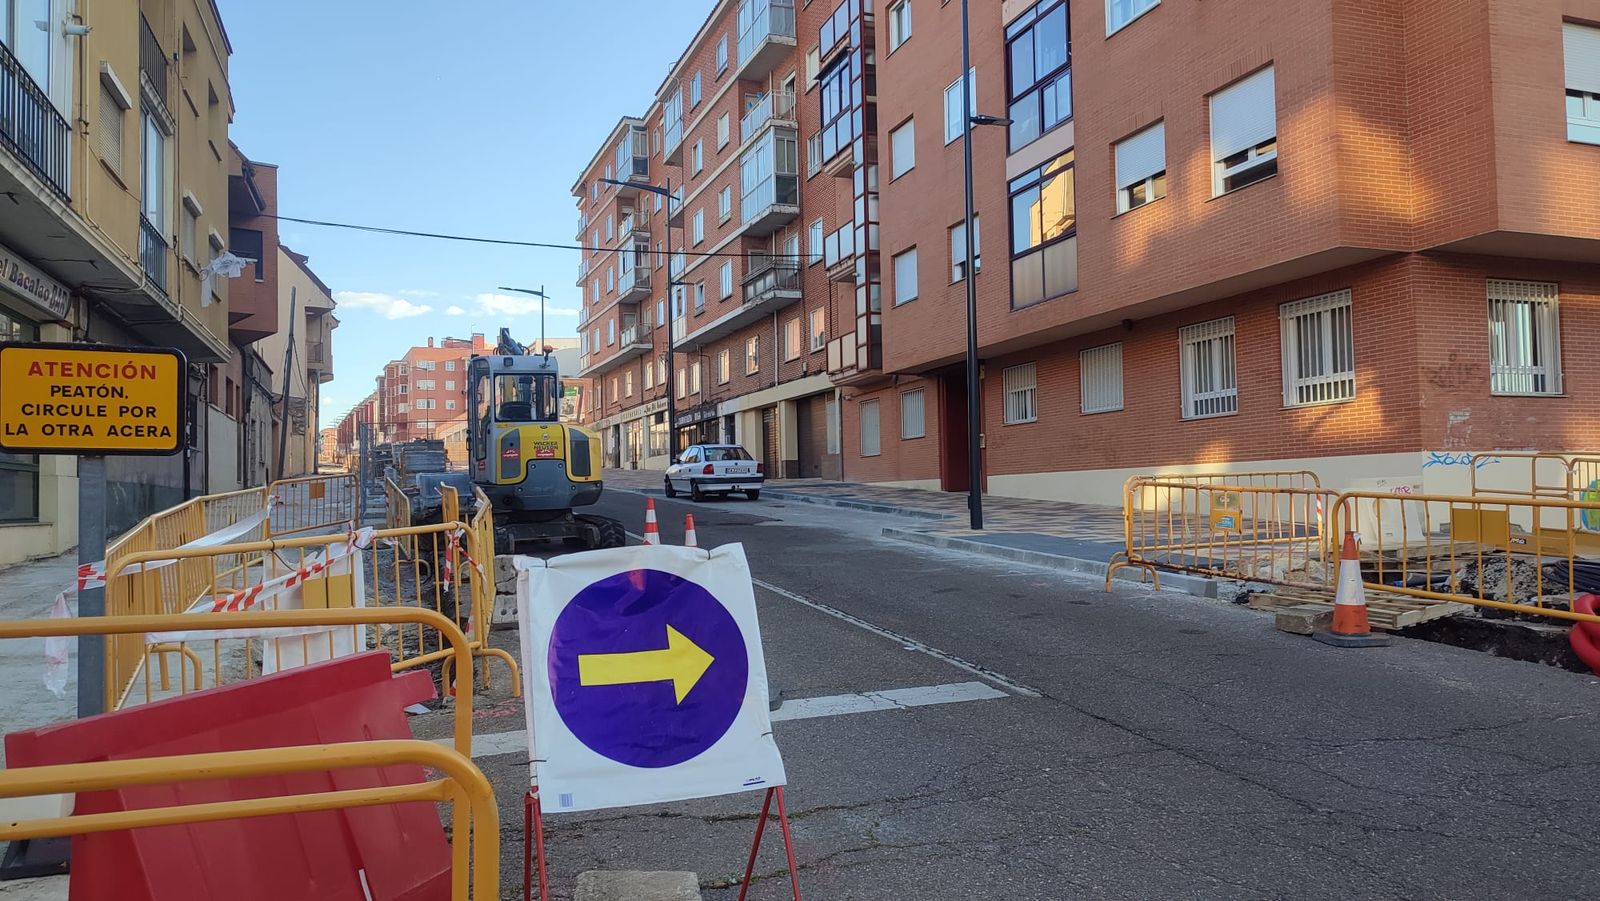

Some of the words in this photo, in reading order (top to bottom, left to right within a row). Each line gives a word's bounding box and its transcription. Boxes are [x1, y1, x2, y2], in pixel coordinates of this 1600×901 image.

[9, 262, 50, 301] Bacalao
[49, 284, 68, 316] BAR
[28, 361, 157, 380] ATENCIÓN
[50, 384, 129, 399] PEATÓN.
[21, 403, 107, 417] CIRCULE
[119, 405, 157, 418] POR
[5, 423, 29, 436] LA
[41, 423, 94, 437] OTRA
[107, 425, 172, 438] ACERA
